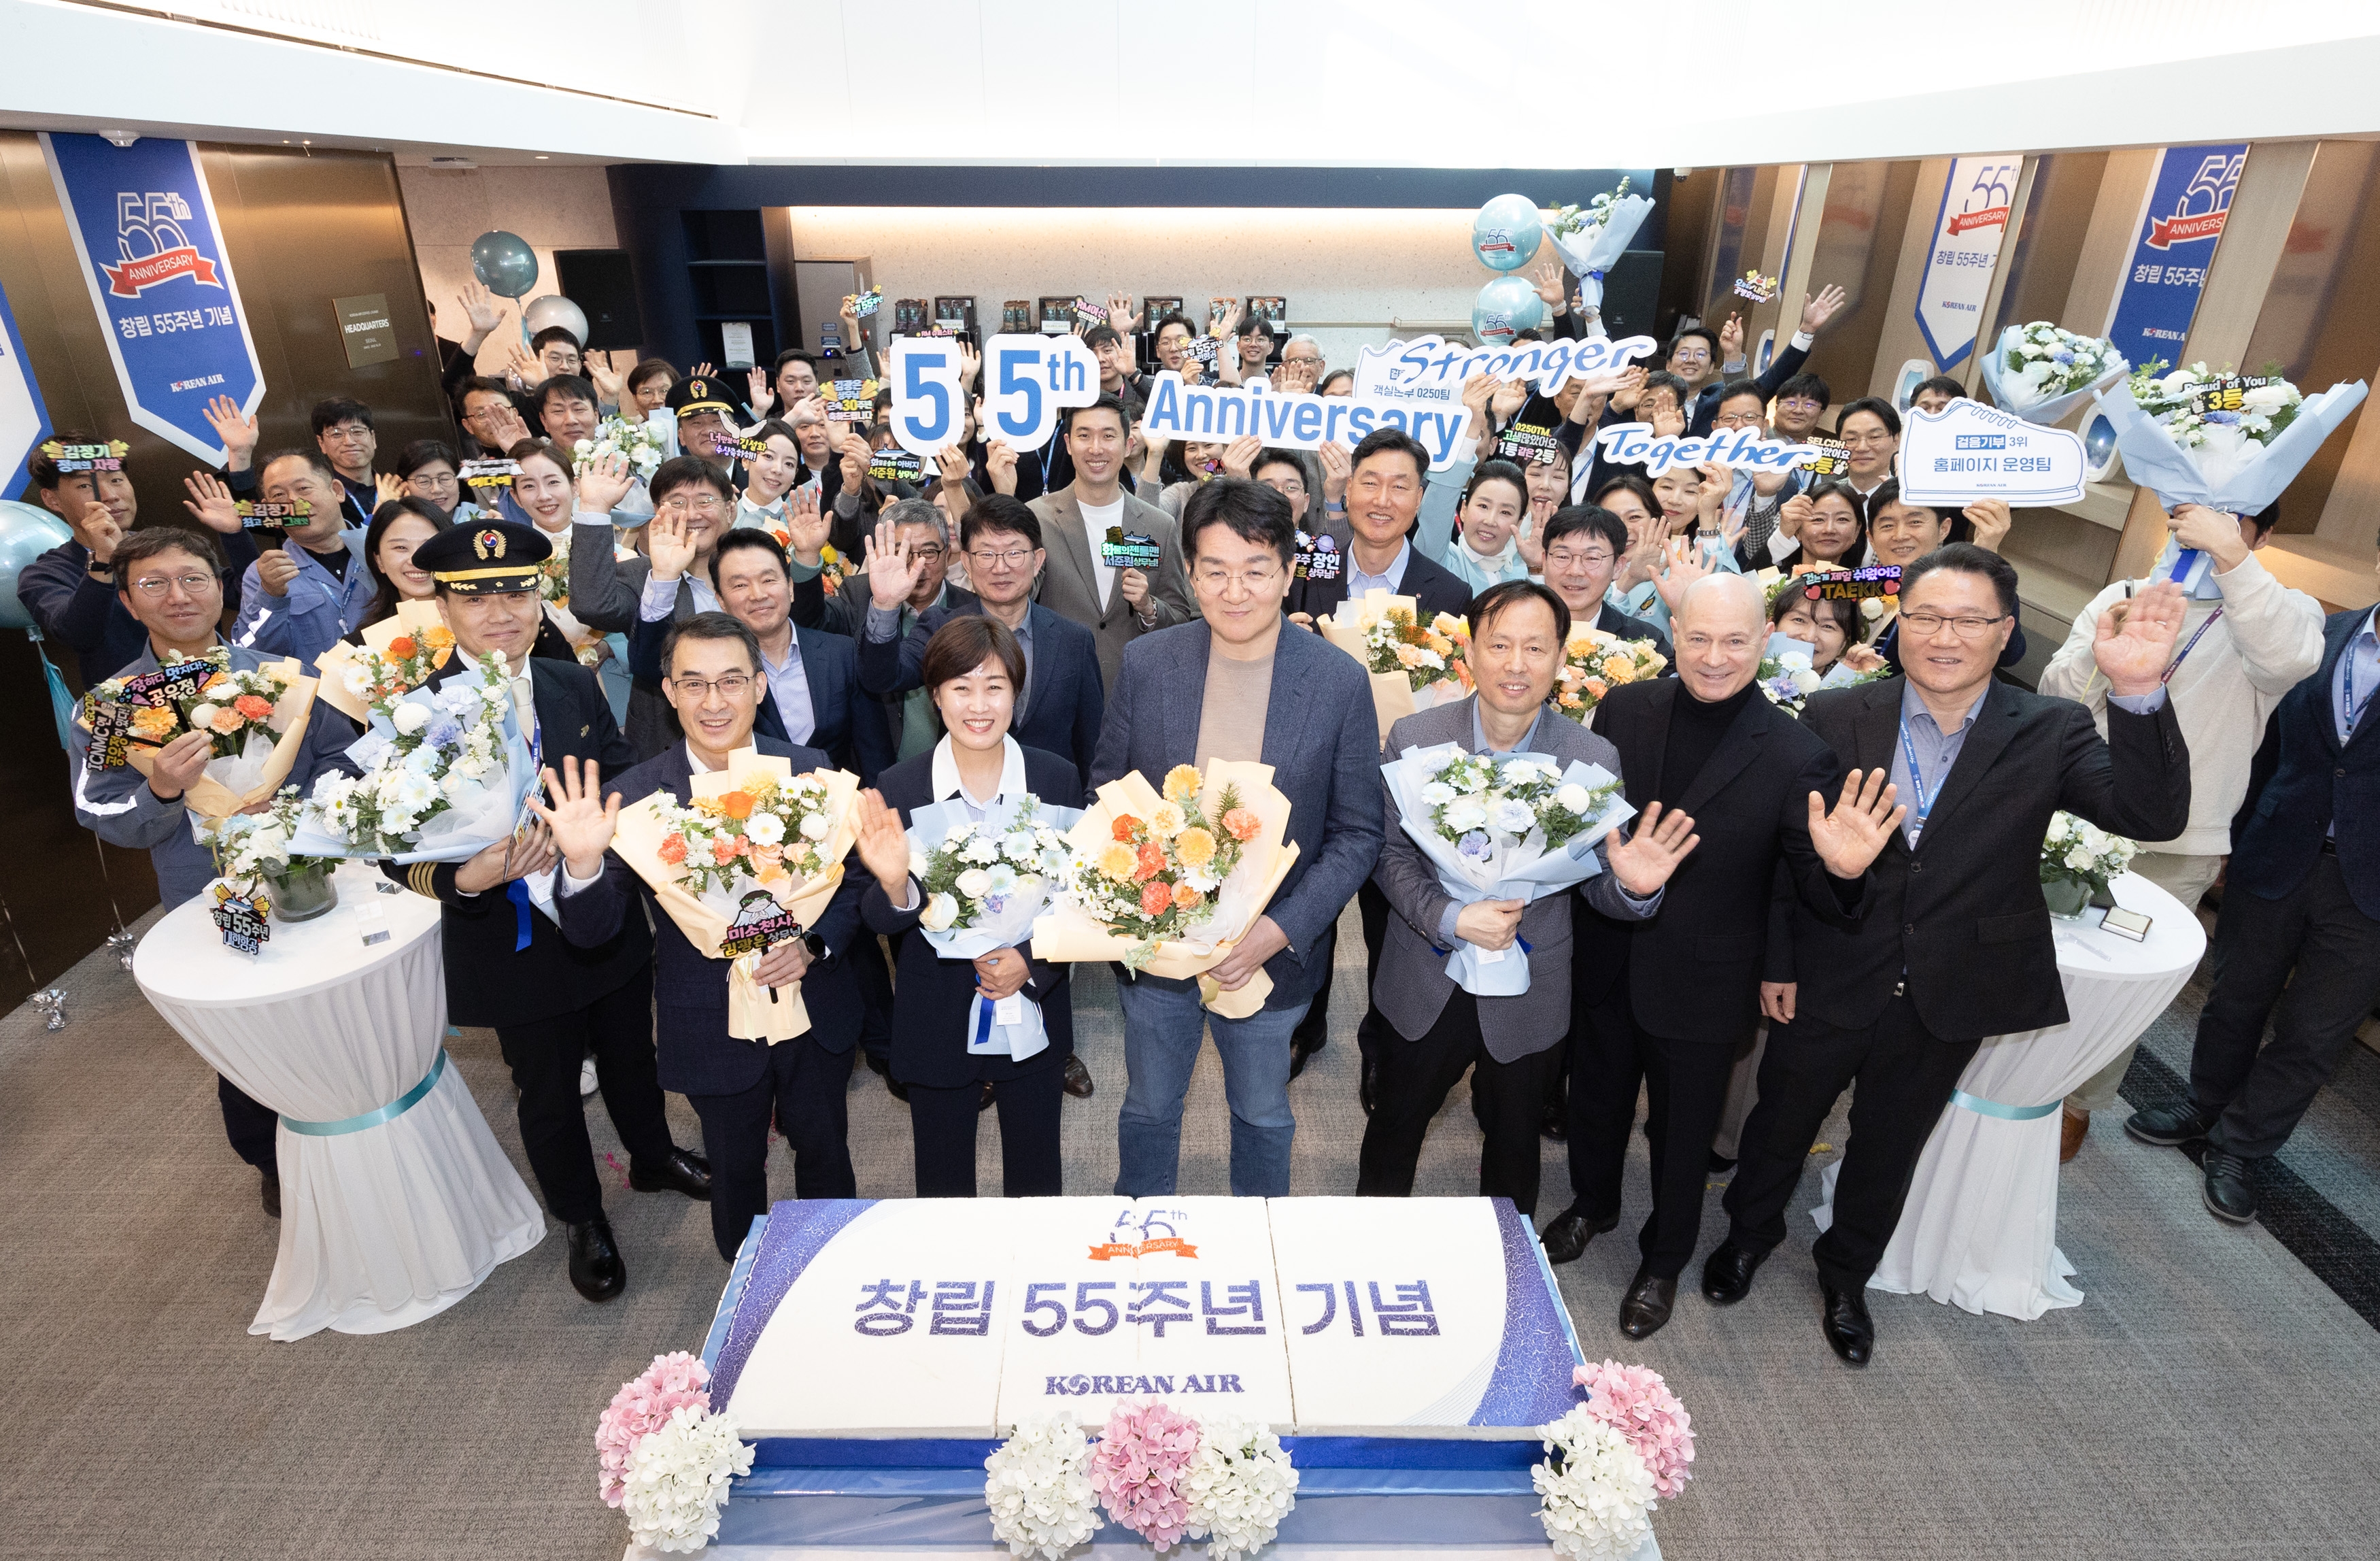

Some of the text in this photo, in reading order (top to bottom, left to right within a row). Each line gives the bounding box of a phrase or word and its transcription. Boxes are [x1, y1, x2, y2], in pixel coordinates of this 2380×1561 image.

[118, 192, 192, 262] 55th
[1959, 212, 2007, 226] ANNIVERSARY
[129, 255, 193, 280] ANNIVERSARY
[1936, 250, 1956, 265] 창립
[1956, 252, 1989, 268] 55주년
[2133, 264, 2163, 284] 창립
[861, 295, 883, 310] 55주년
[1942, 301, 1965, 310] KOREAN
[118, 305, 233, 339] 창립 55주년 기념
[344, 318, 390, 333] HEADQUARTERS
[2142, 327, 2178, 340] KOREAN
[1195, 339, 1223, 354] 55주년
[1400, 342, 1648, 389] Stronger
[170, 373, 225, 392] KOREAN AIR
[2226, 377, 2241, 389] of
[2243, 376, 2266, 388] You
[1417, 388, 1450, 400] 0250팀
[2208, 388, 2243, 410] 3등
[1149, 378, 1463, 463] Anniversary
[1515, 422, 1550, 437] 0250TM
[1503, 429, 1557, 449] 고생많았어요
[1806, 436, 1846, 450] SELCDH
[1956, 436, 2028, 449] 걸음기부 3위
[63, 444, 112, 459] 김정기
[715, 444, 757, 462] 수상축하해!
[1605, 429, 1814, 470] Together
[1822, 447, 1851, 460] 았어요
[868, 467, 919, 480] 서준원 상무님!
[897, 460, 920, 469] 아버지
[1934, 457, 2051, 472] 홈페이지 운영팀
[253, 503, 296, 516] 김정기
[1312, 552, 1340, 570] 장인
[1308, 568, 1335, 579] 상무님!
[1803, 565, 1902, 585] 걷는게 제일 쉬웠어요
[1822, 581, 1884, 600] TAEKK
[128, 660, 204, 692] 장하다 멋지다!
[148, 678, 197, 707] 공우정
[84, 692, 96, 722] GOOD!
[214, 910, 269, 941] 창립 55주년
[728, 915, 794, 940] 미소천사
[223, 929, 258, 954] 대한항공
[721, 926, 802, 957] 김광은 상무님
[854, 1279, 1441, 1338] 창립 55주년 기념
[1044, 1373, 1245, 1396] KOREAN AIR
